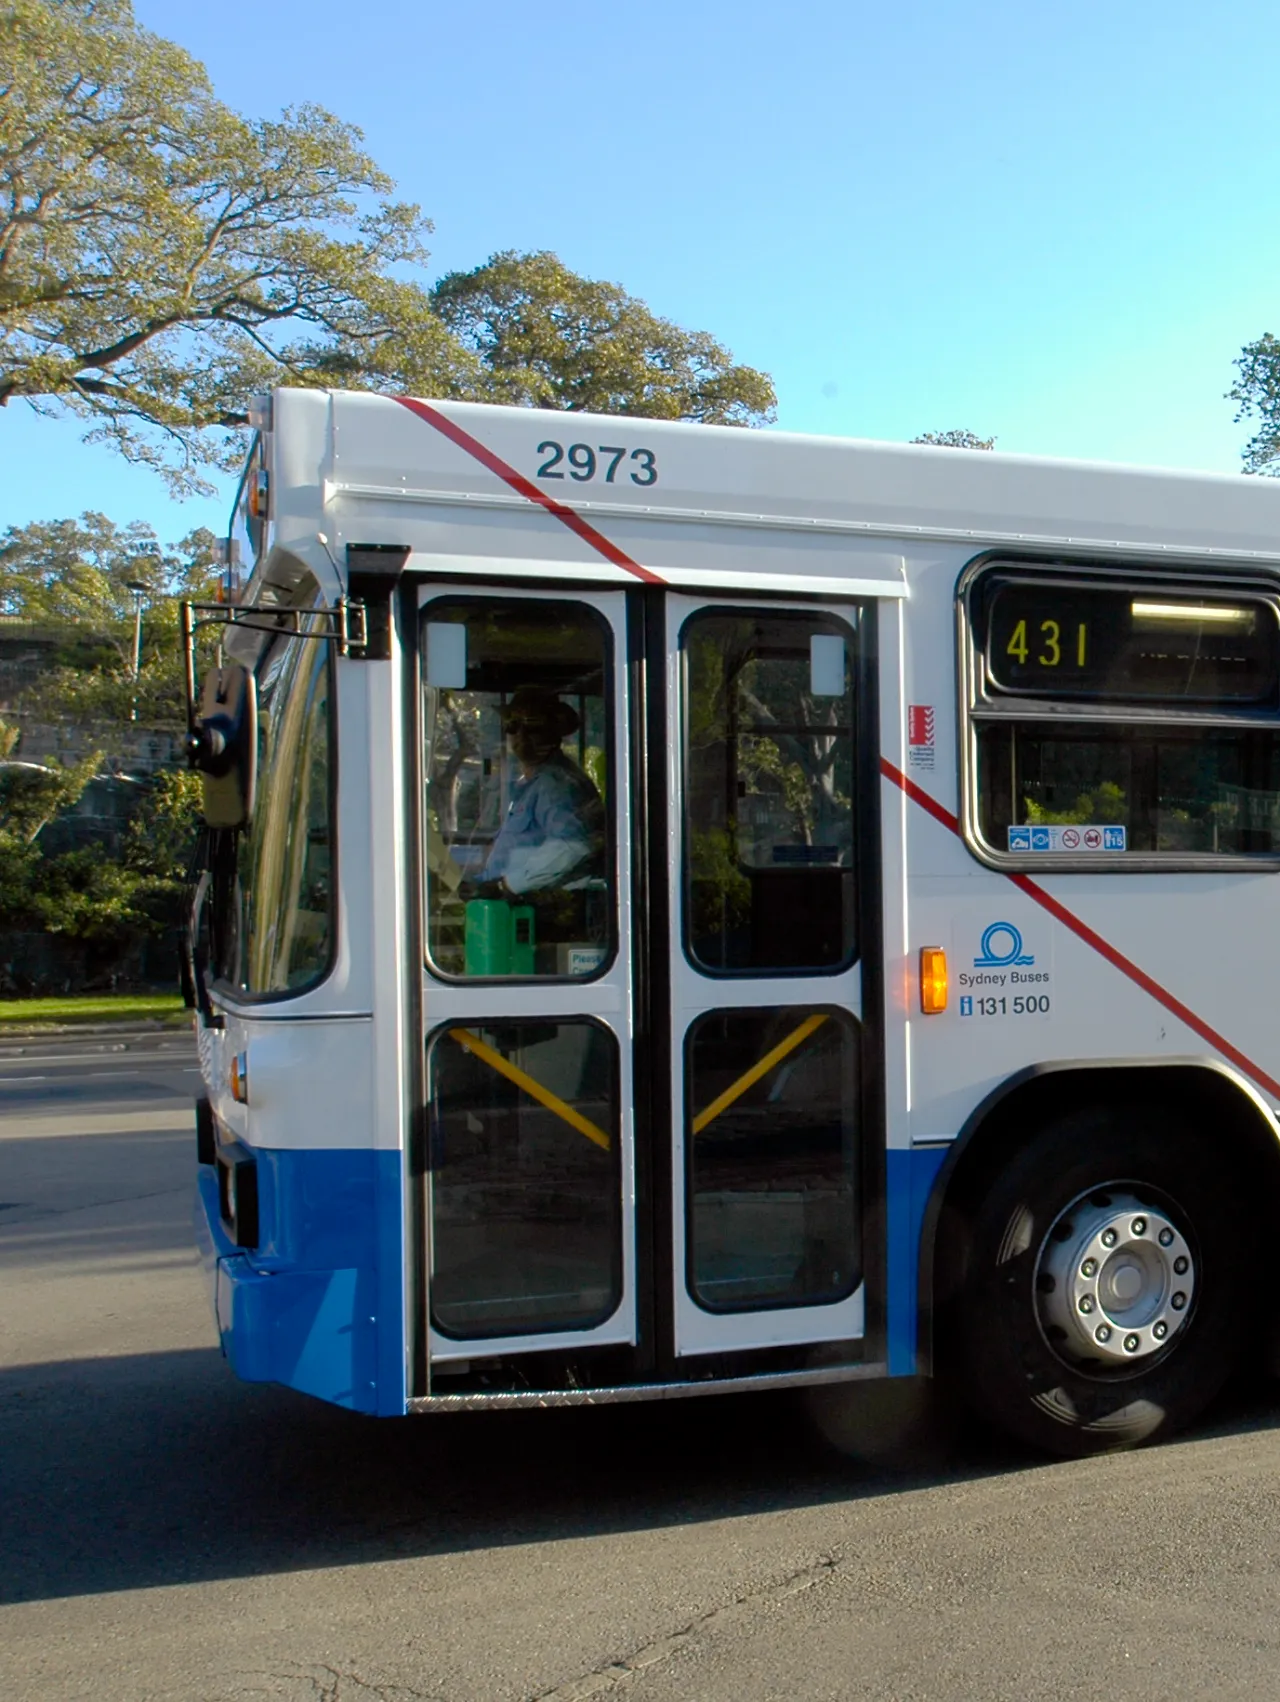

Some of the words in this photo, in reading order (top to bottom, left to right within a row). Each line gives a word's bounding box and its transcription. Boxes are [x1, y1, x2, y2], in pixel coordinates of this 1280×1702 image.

[537, 440, 658, 486] 2973
[1006, 619, 1087, 667] 431
[959, 973, 1007, 987] Sydney
[1010, 971, 1050, 984] Buses
[977, 996, 1007, 1016] 131
[1013, 995, 1050, 1014] 500
